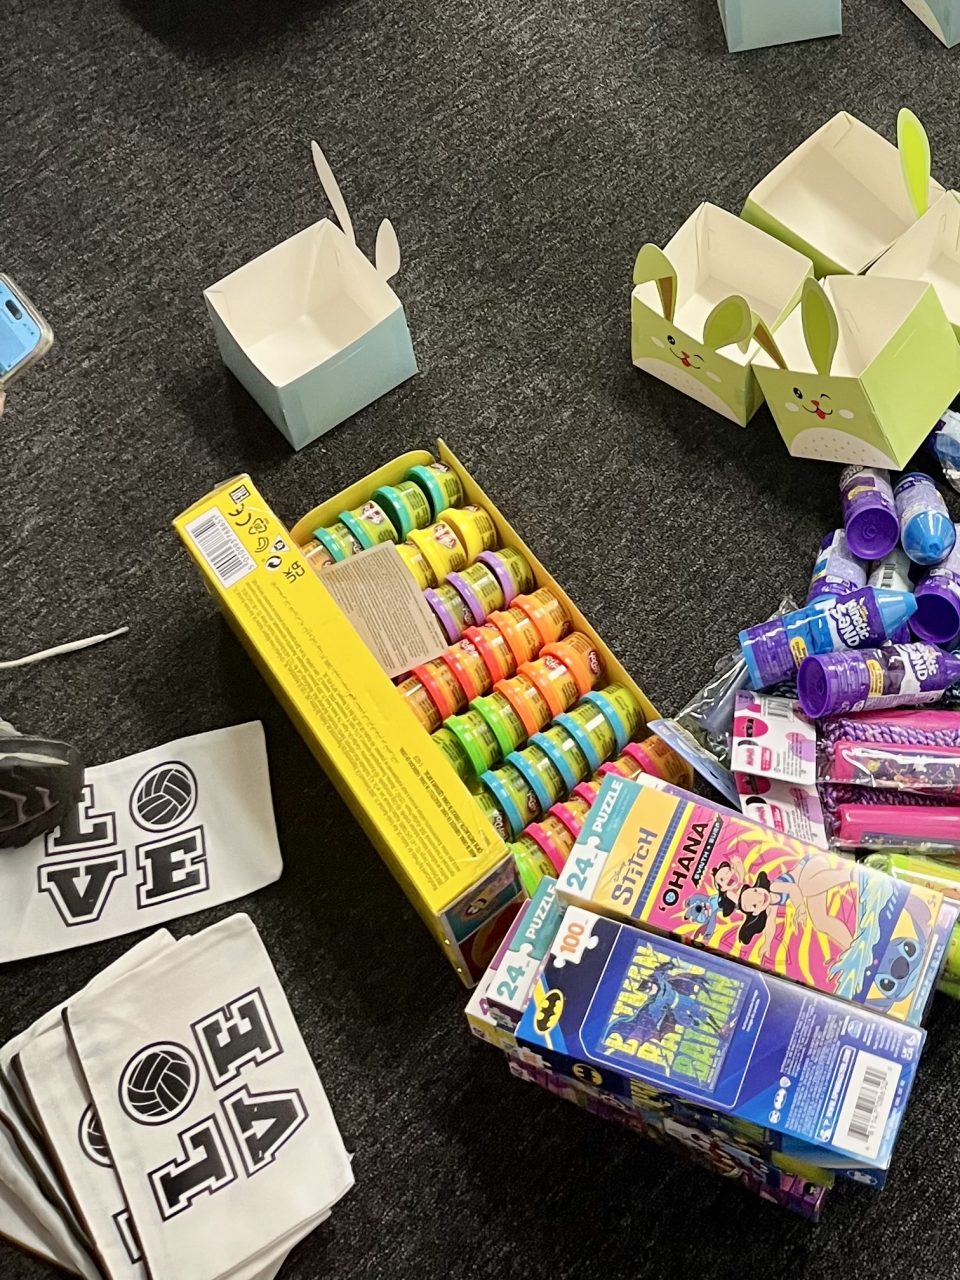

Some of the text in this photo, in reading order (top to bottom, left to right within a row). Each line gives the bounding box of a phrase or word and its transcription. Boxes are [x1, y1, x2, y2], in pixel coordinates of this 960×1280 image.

[566, 780, 624, 892] 24 PUZZLE
[559, 921, 585, 954] 100
[496, 963, 526, 1002] 24
